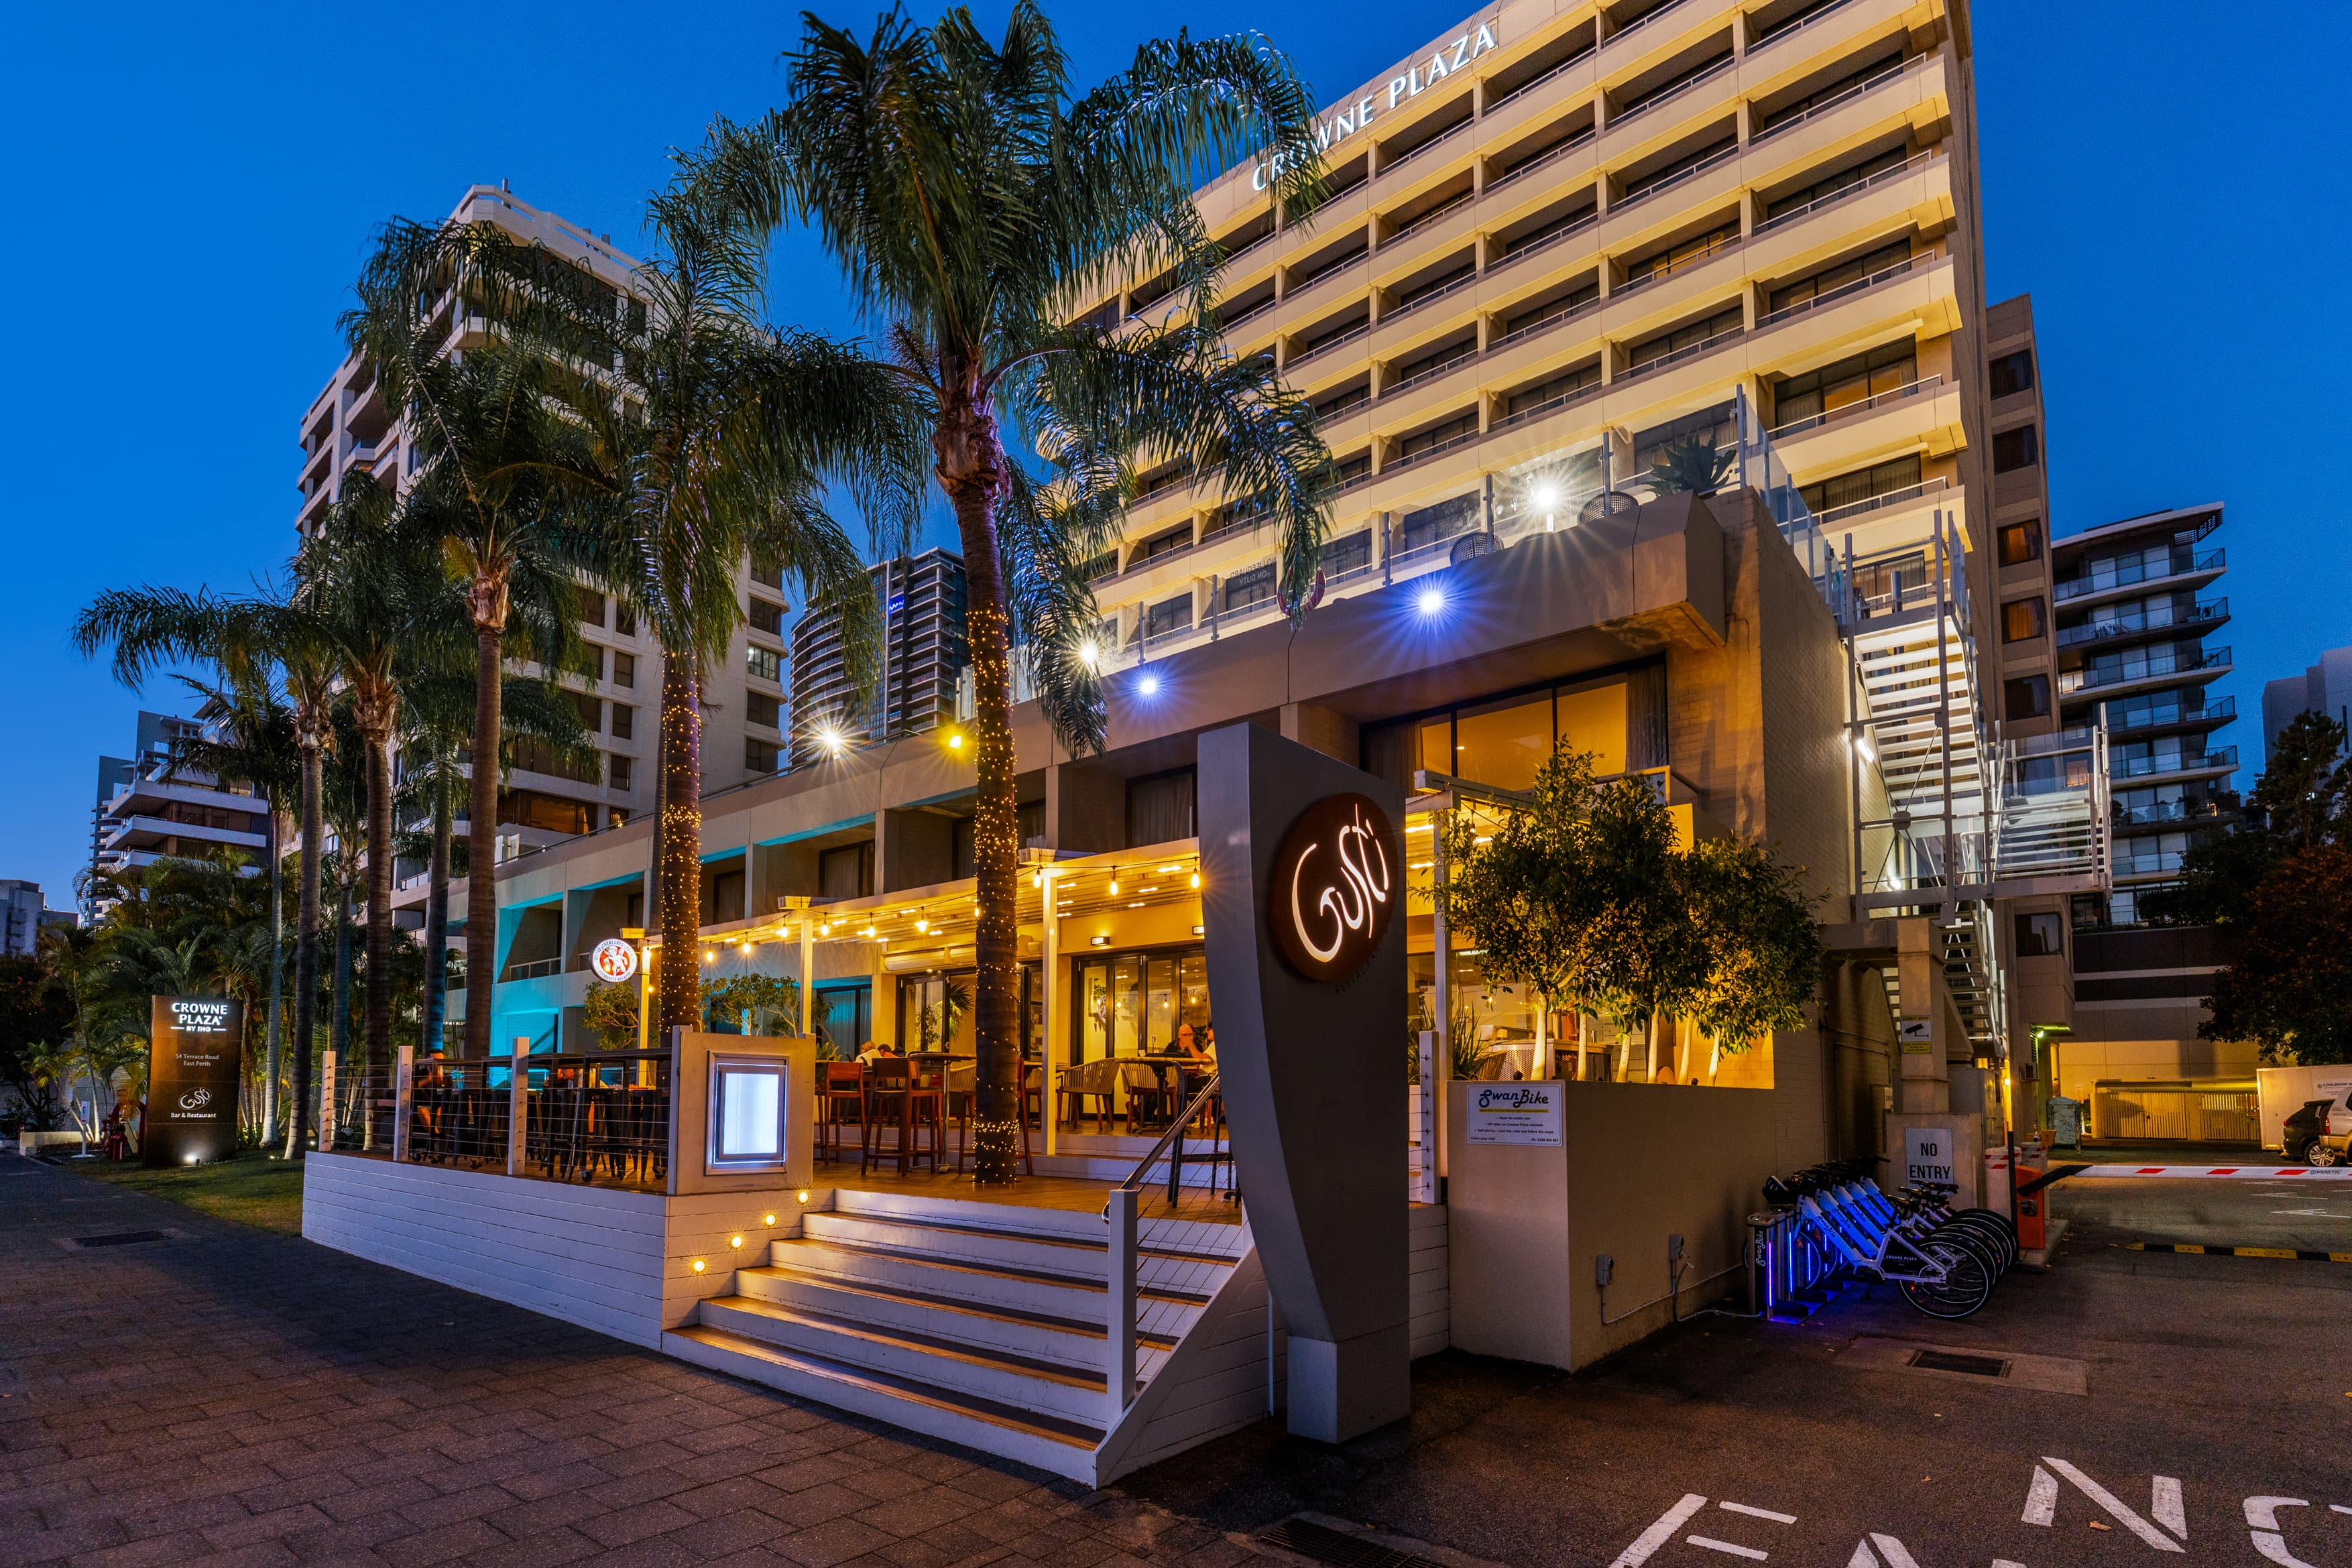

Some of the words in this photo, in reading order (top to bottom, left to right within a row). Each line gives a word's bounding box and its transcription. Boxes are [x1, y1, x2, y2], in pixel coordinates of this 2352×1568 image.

[1252, 94, 1374, 192] CROWNE
[1389, 23, 1496, 110] PLAZA
[172, 1002, 228, 1015] CROWNE
[179, 1014, 223, 1026] PLAZA
[1478, 1089, 1549, 1108] SwanBike
[1920, 1143, 1938, 1156] NO
[1909, 1165, 1951, 1179] ENTRY
